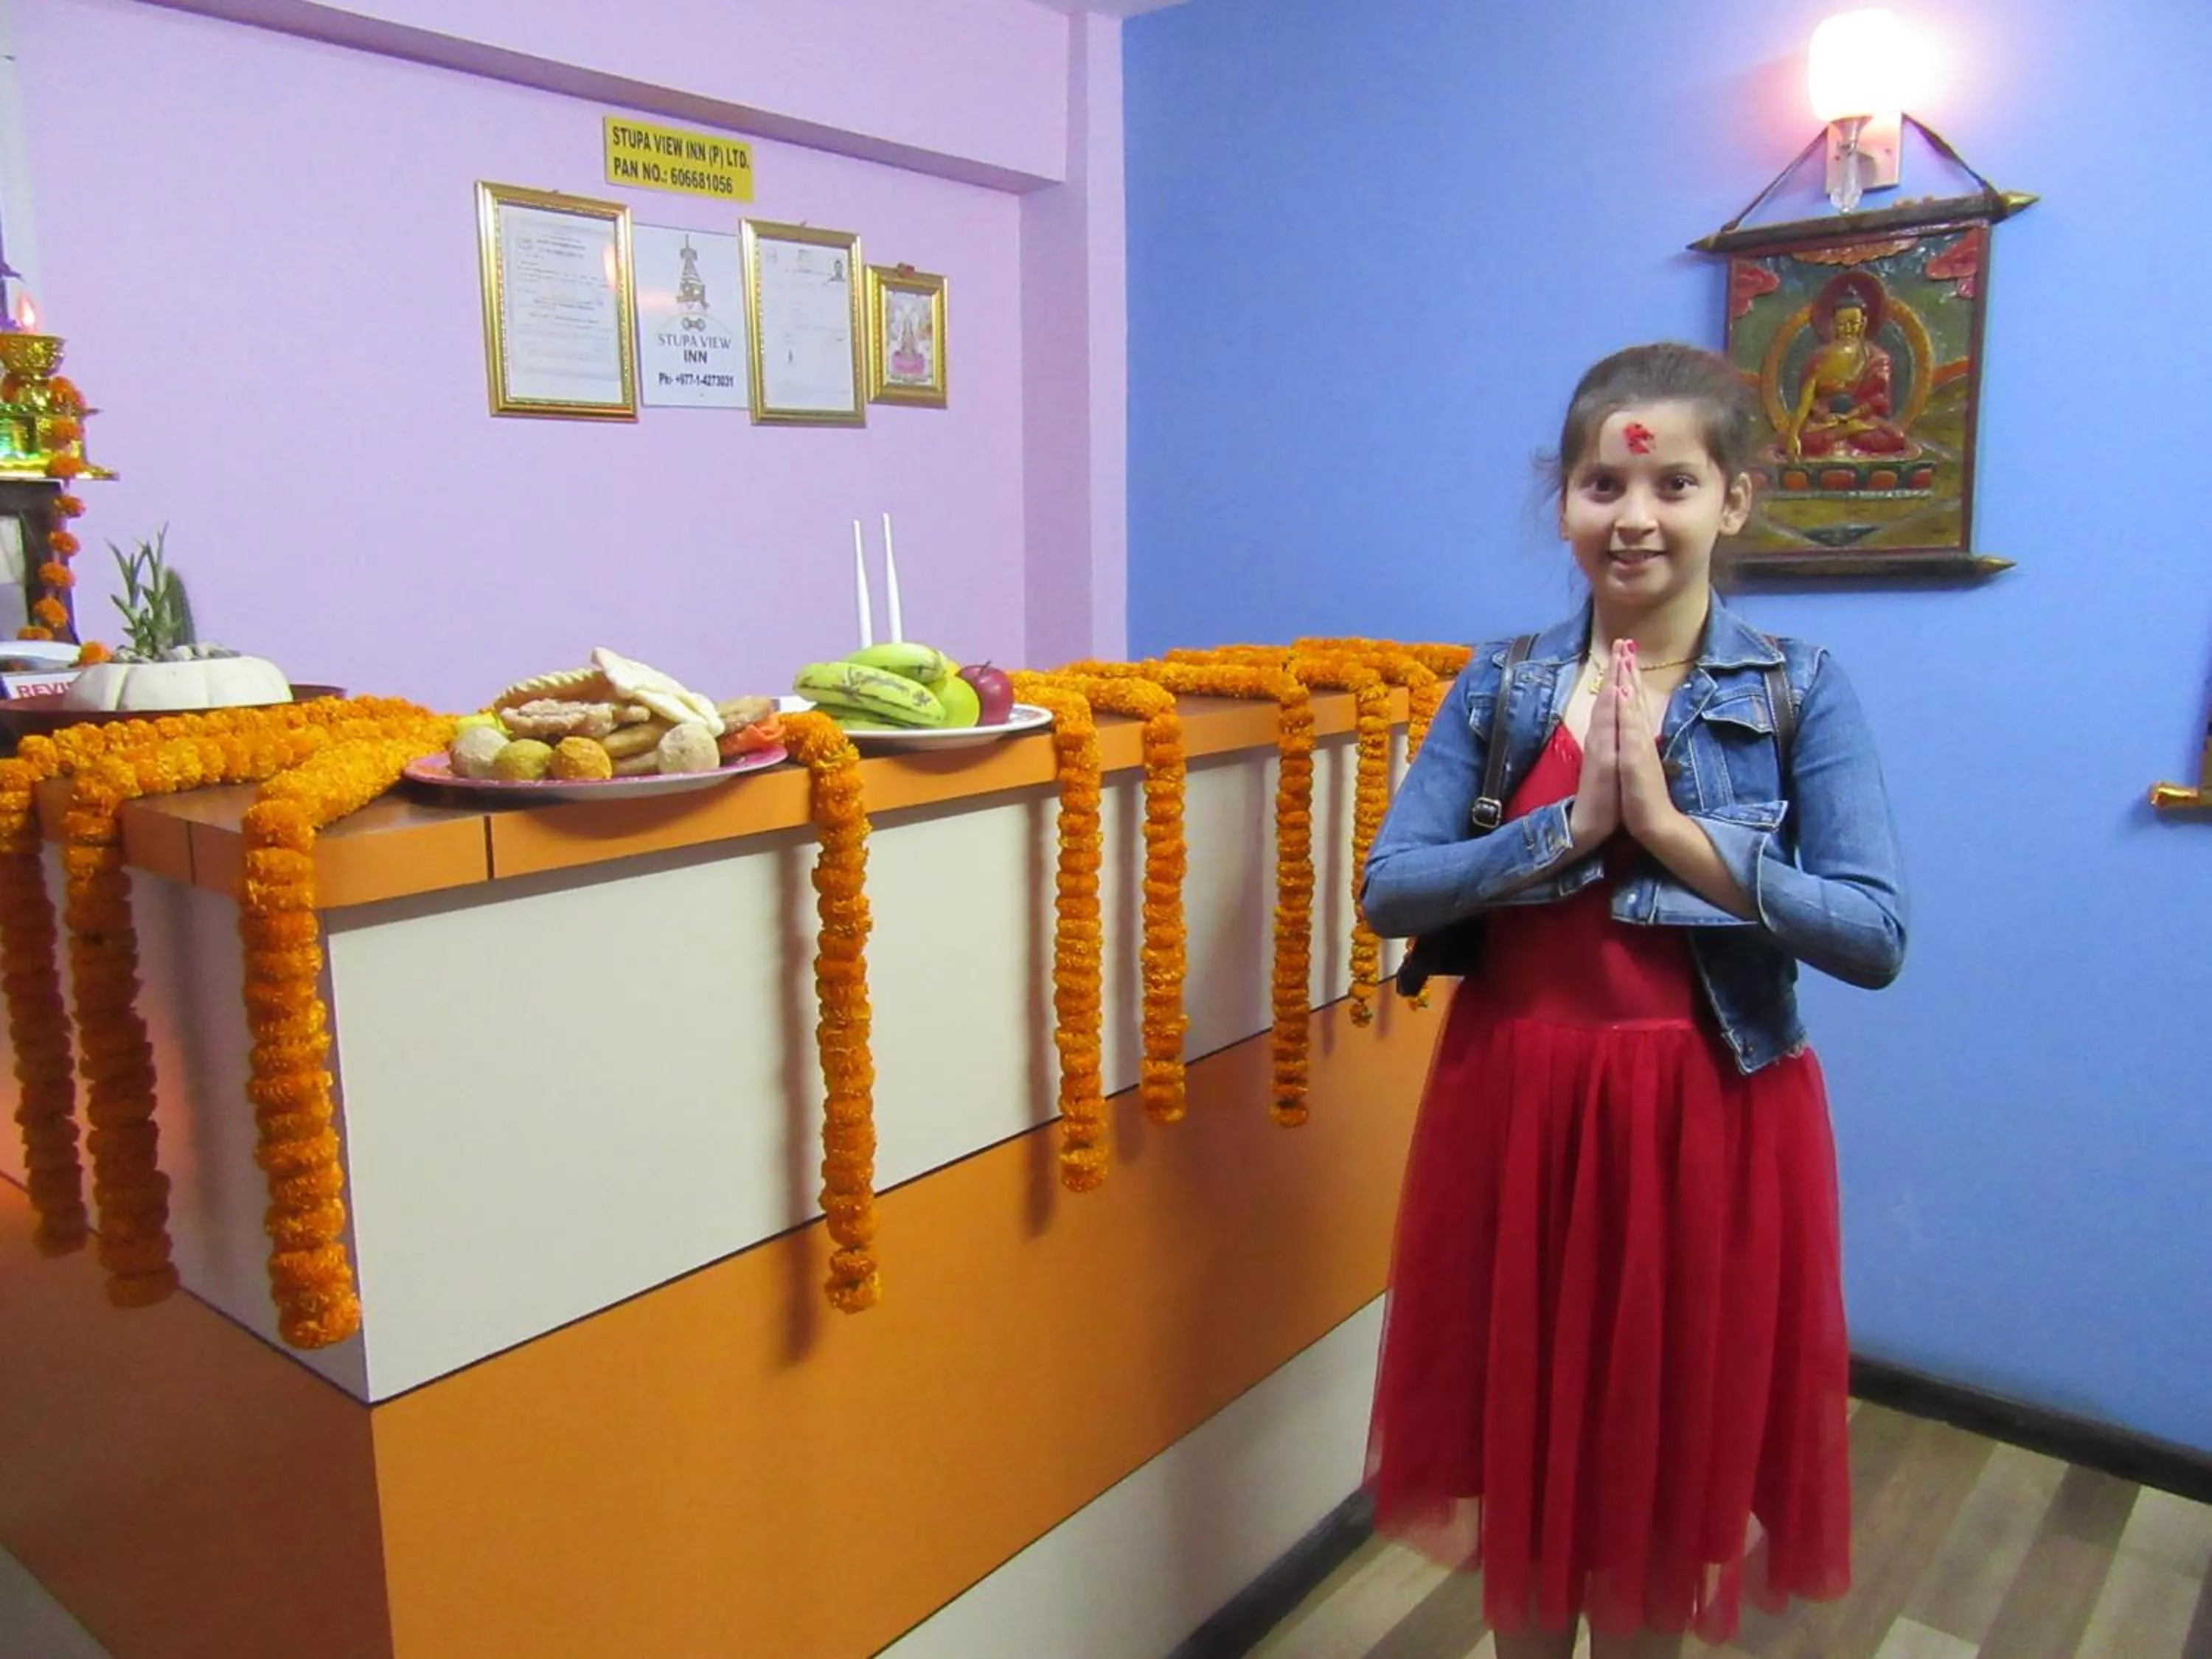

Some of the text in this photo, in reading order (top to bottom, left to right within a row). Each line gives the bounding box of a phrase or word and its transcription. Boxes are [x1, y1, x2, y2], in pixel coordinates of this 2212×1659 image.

[613, 126, 750, 170] STUPA VIEW INN (P) LTD.
[613, 156, 639, 178] PAN
[670, 167, 733, 195] 606681056
[658, 334, 731, 349] STUPA VIEW
[684, 349, 707, 364] INN
